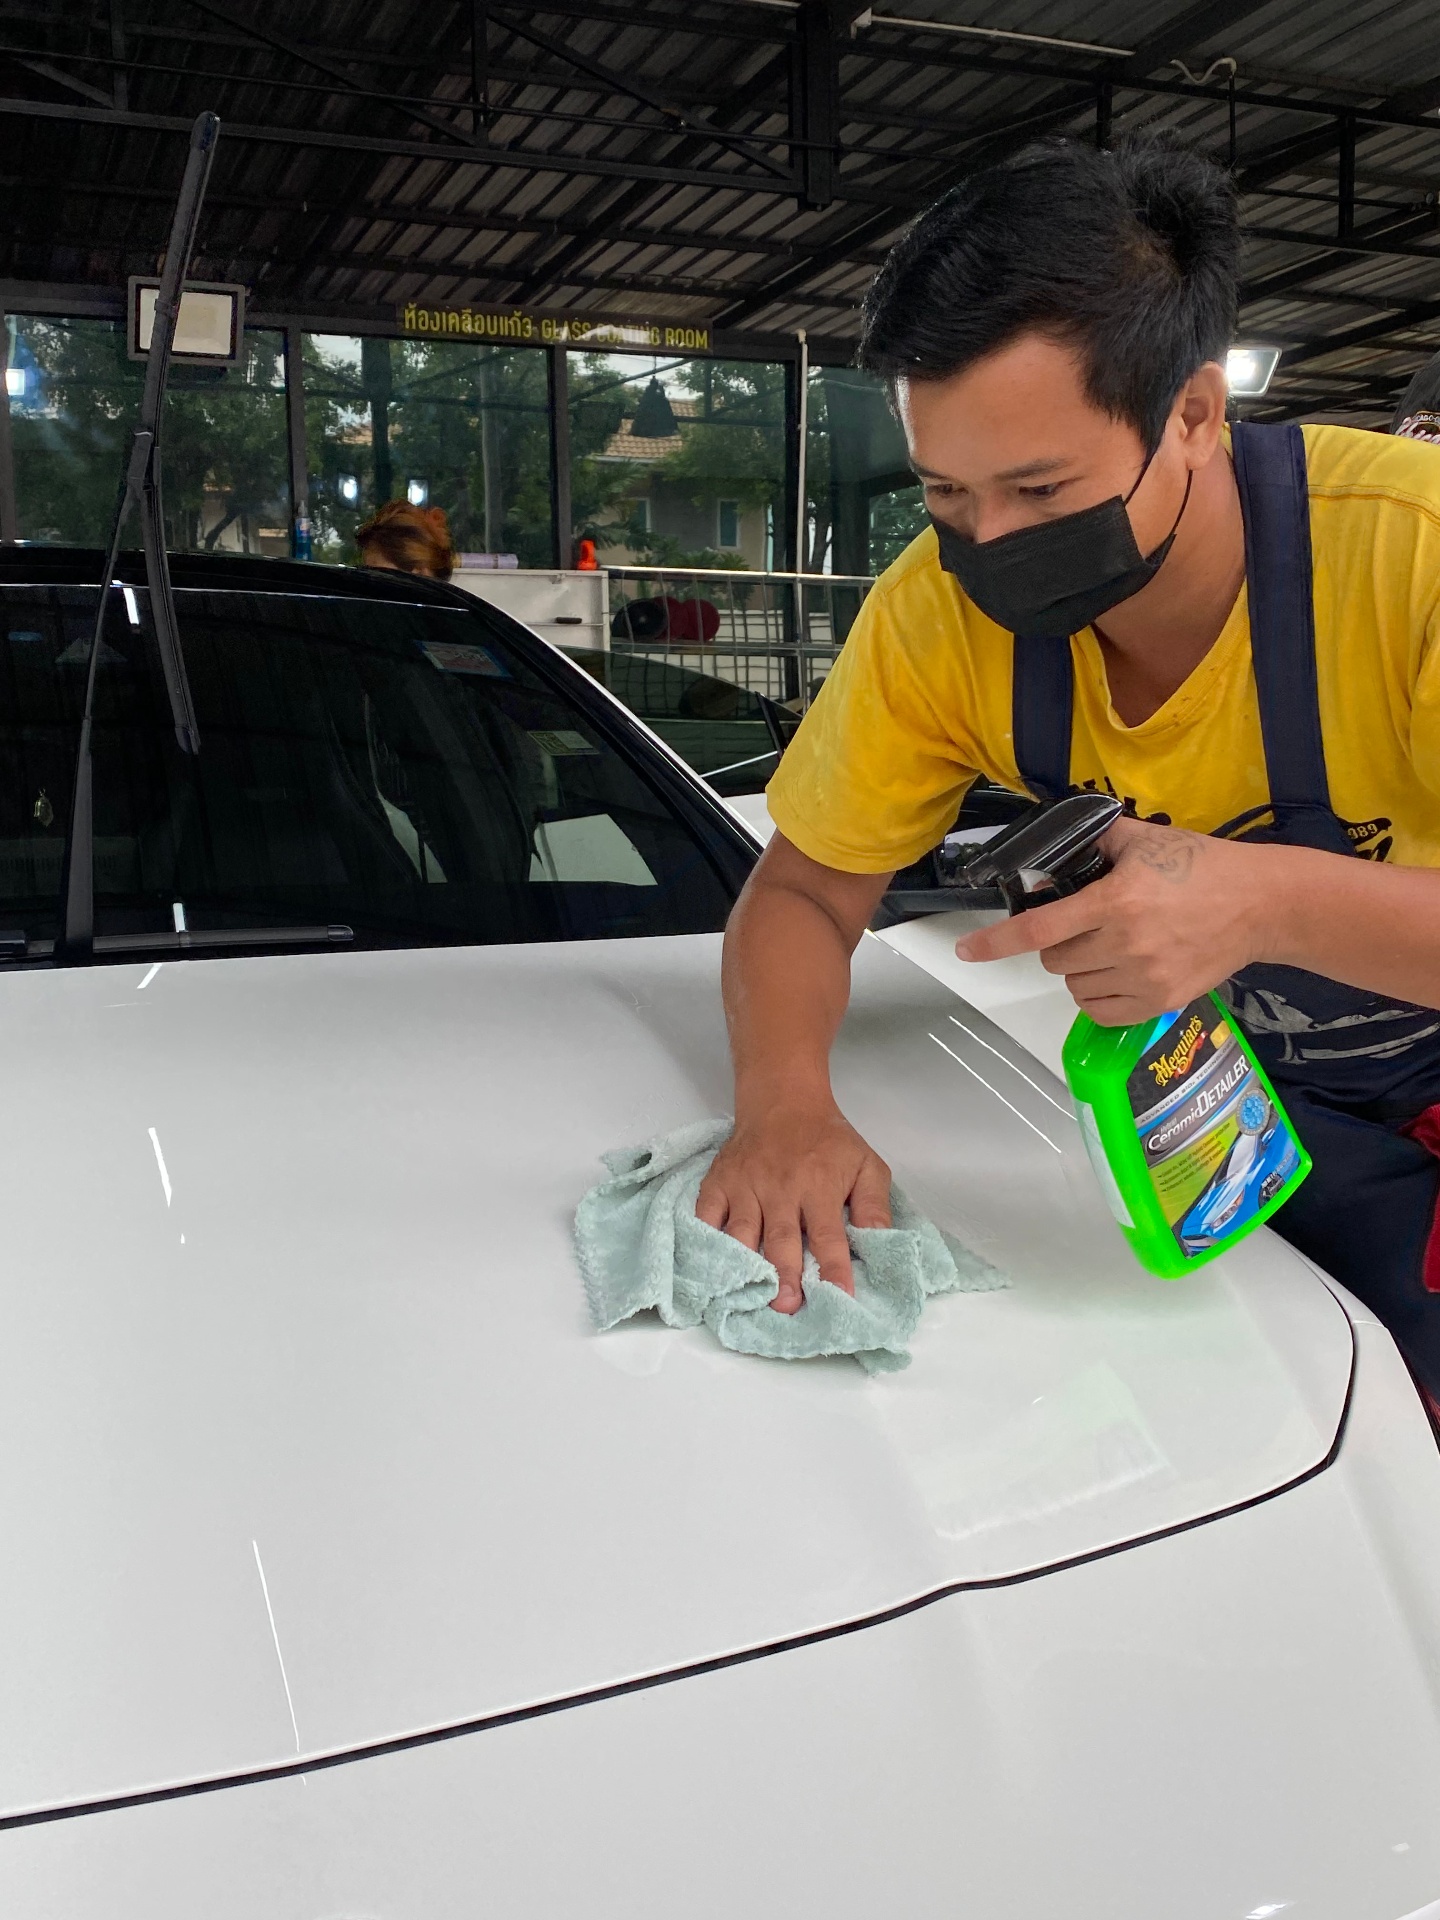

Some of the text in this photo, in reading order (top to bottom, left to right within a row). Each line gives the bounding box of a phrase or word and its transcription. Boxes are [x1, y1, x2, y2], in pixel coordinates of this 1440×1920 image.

[404, 302, 532, 338] ห้องเคลือบแก้ว
[541, 318, 592, 342] GLASS
[665, 327, 708, 349] ROOM
[1148, 1014, 1204, 1087] Meguiar's
[1140, 1093, 1180, 1124] ADVANCED
